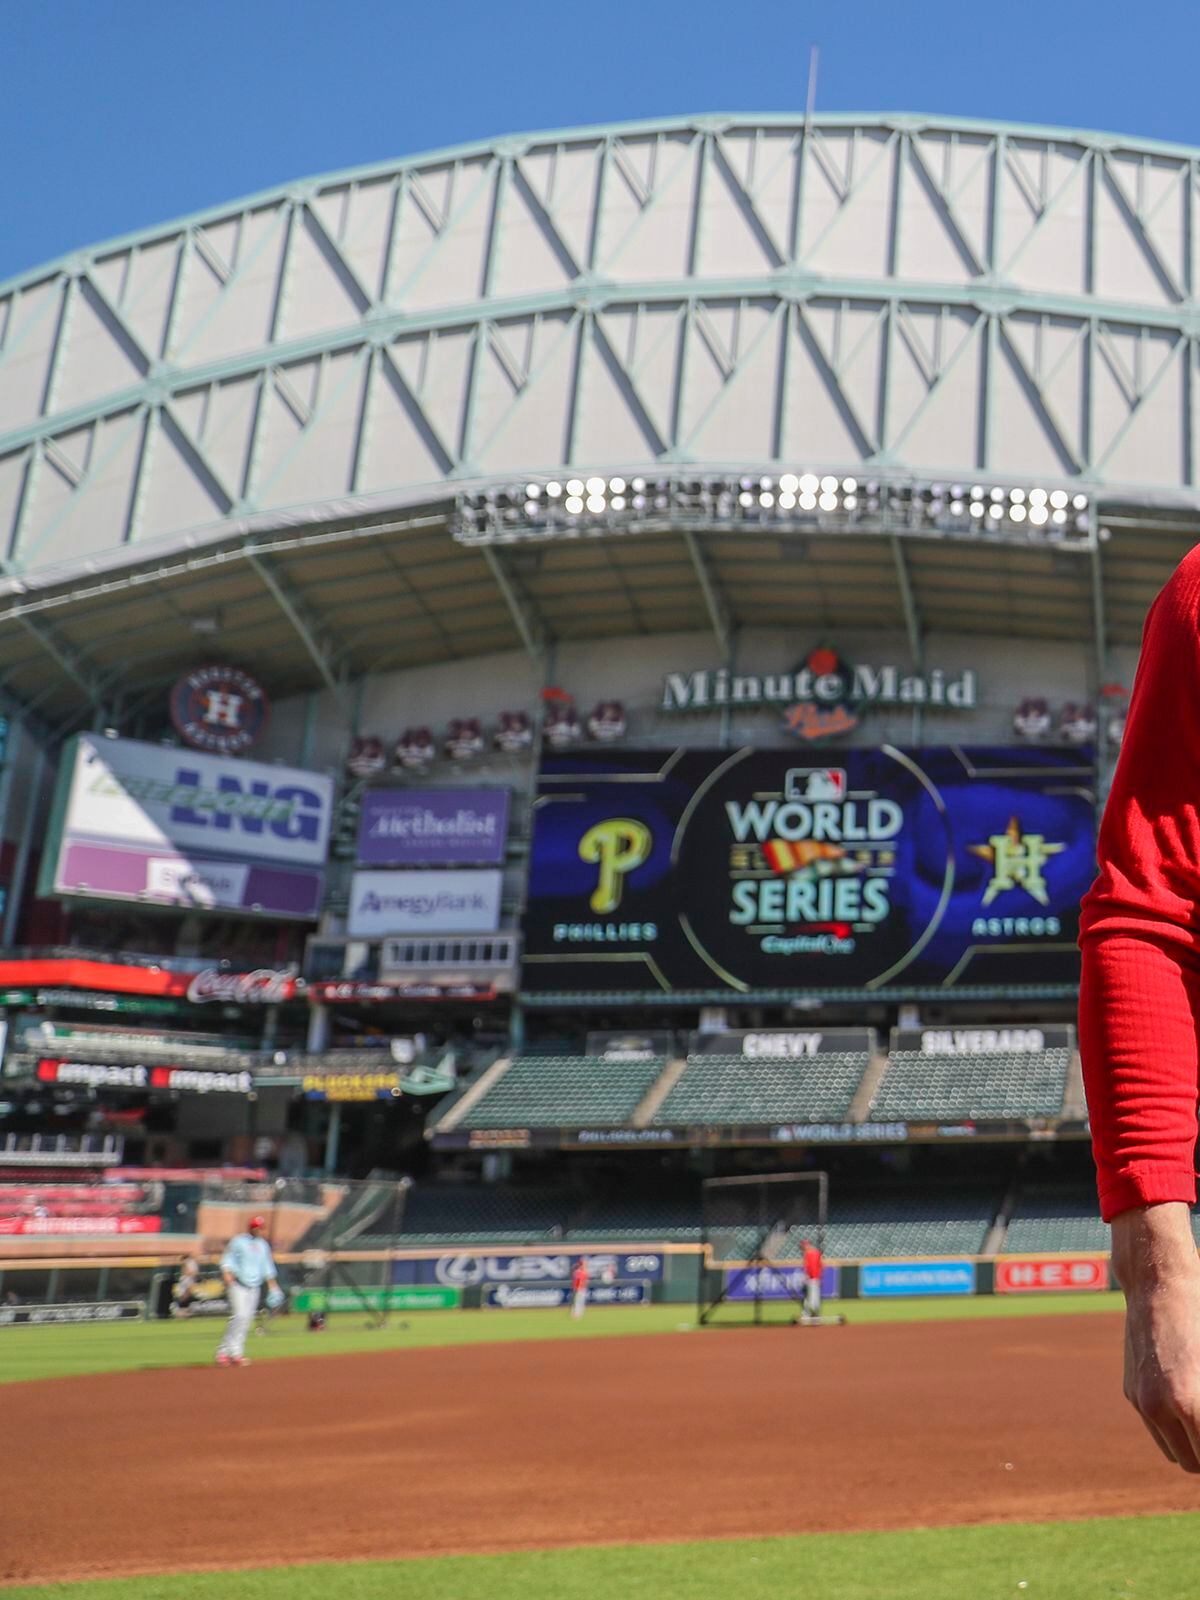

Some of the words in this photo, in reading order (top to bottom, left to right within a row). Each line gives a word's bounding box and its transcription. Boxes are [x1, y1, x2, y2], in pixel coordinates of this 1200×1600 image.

[663, 669, 843, 708] Minute
[853, 664, 978, 705] Maid
[203, 689, 243, 728] H
[170, 767, 323, 842] LNG
[724, 799, 904, 843] WORLD
[578, 818, 652, 914] P
[728, 878, 890, 925] SERIES
[553, 923, 658, 942] PHILLIES
[971, 916, 1061, 937] ASTROS
[742, 1032, 824, 1058] CHEVY
[920, 1029, 1045, 1053] SILVERADO
[57, 1062, 148, 1088] impact
[169, 1070, 252, 1093] impact
[793, 1123, 852, 1142] WORLD
[852, 1122, 908, 1142] SERIES
